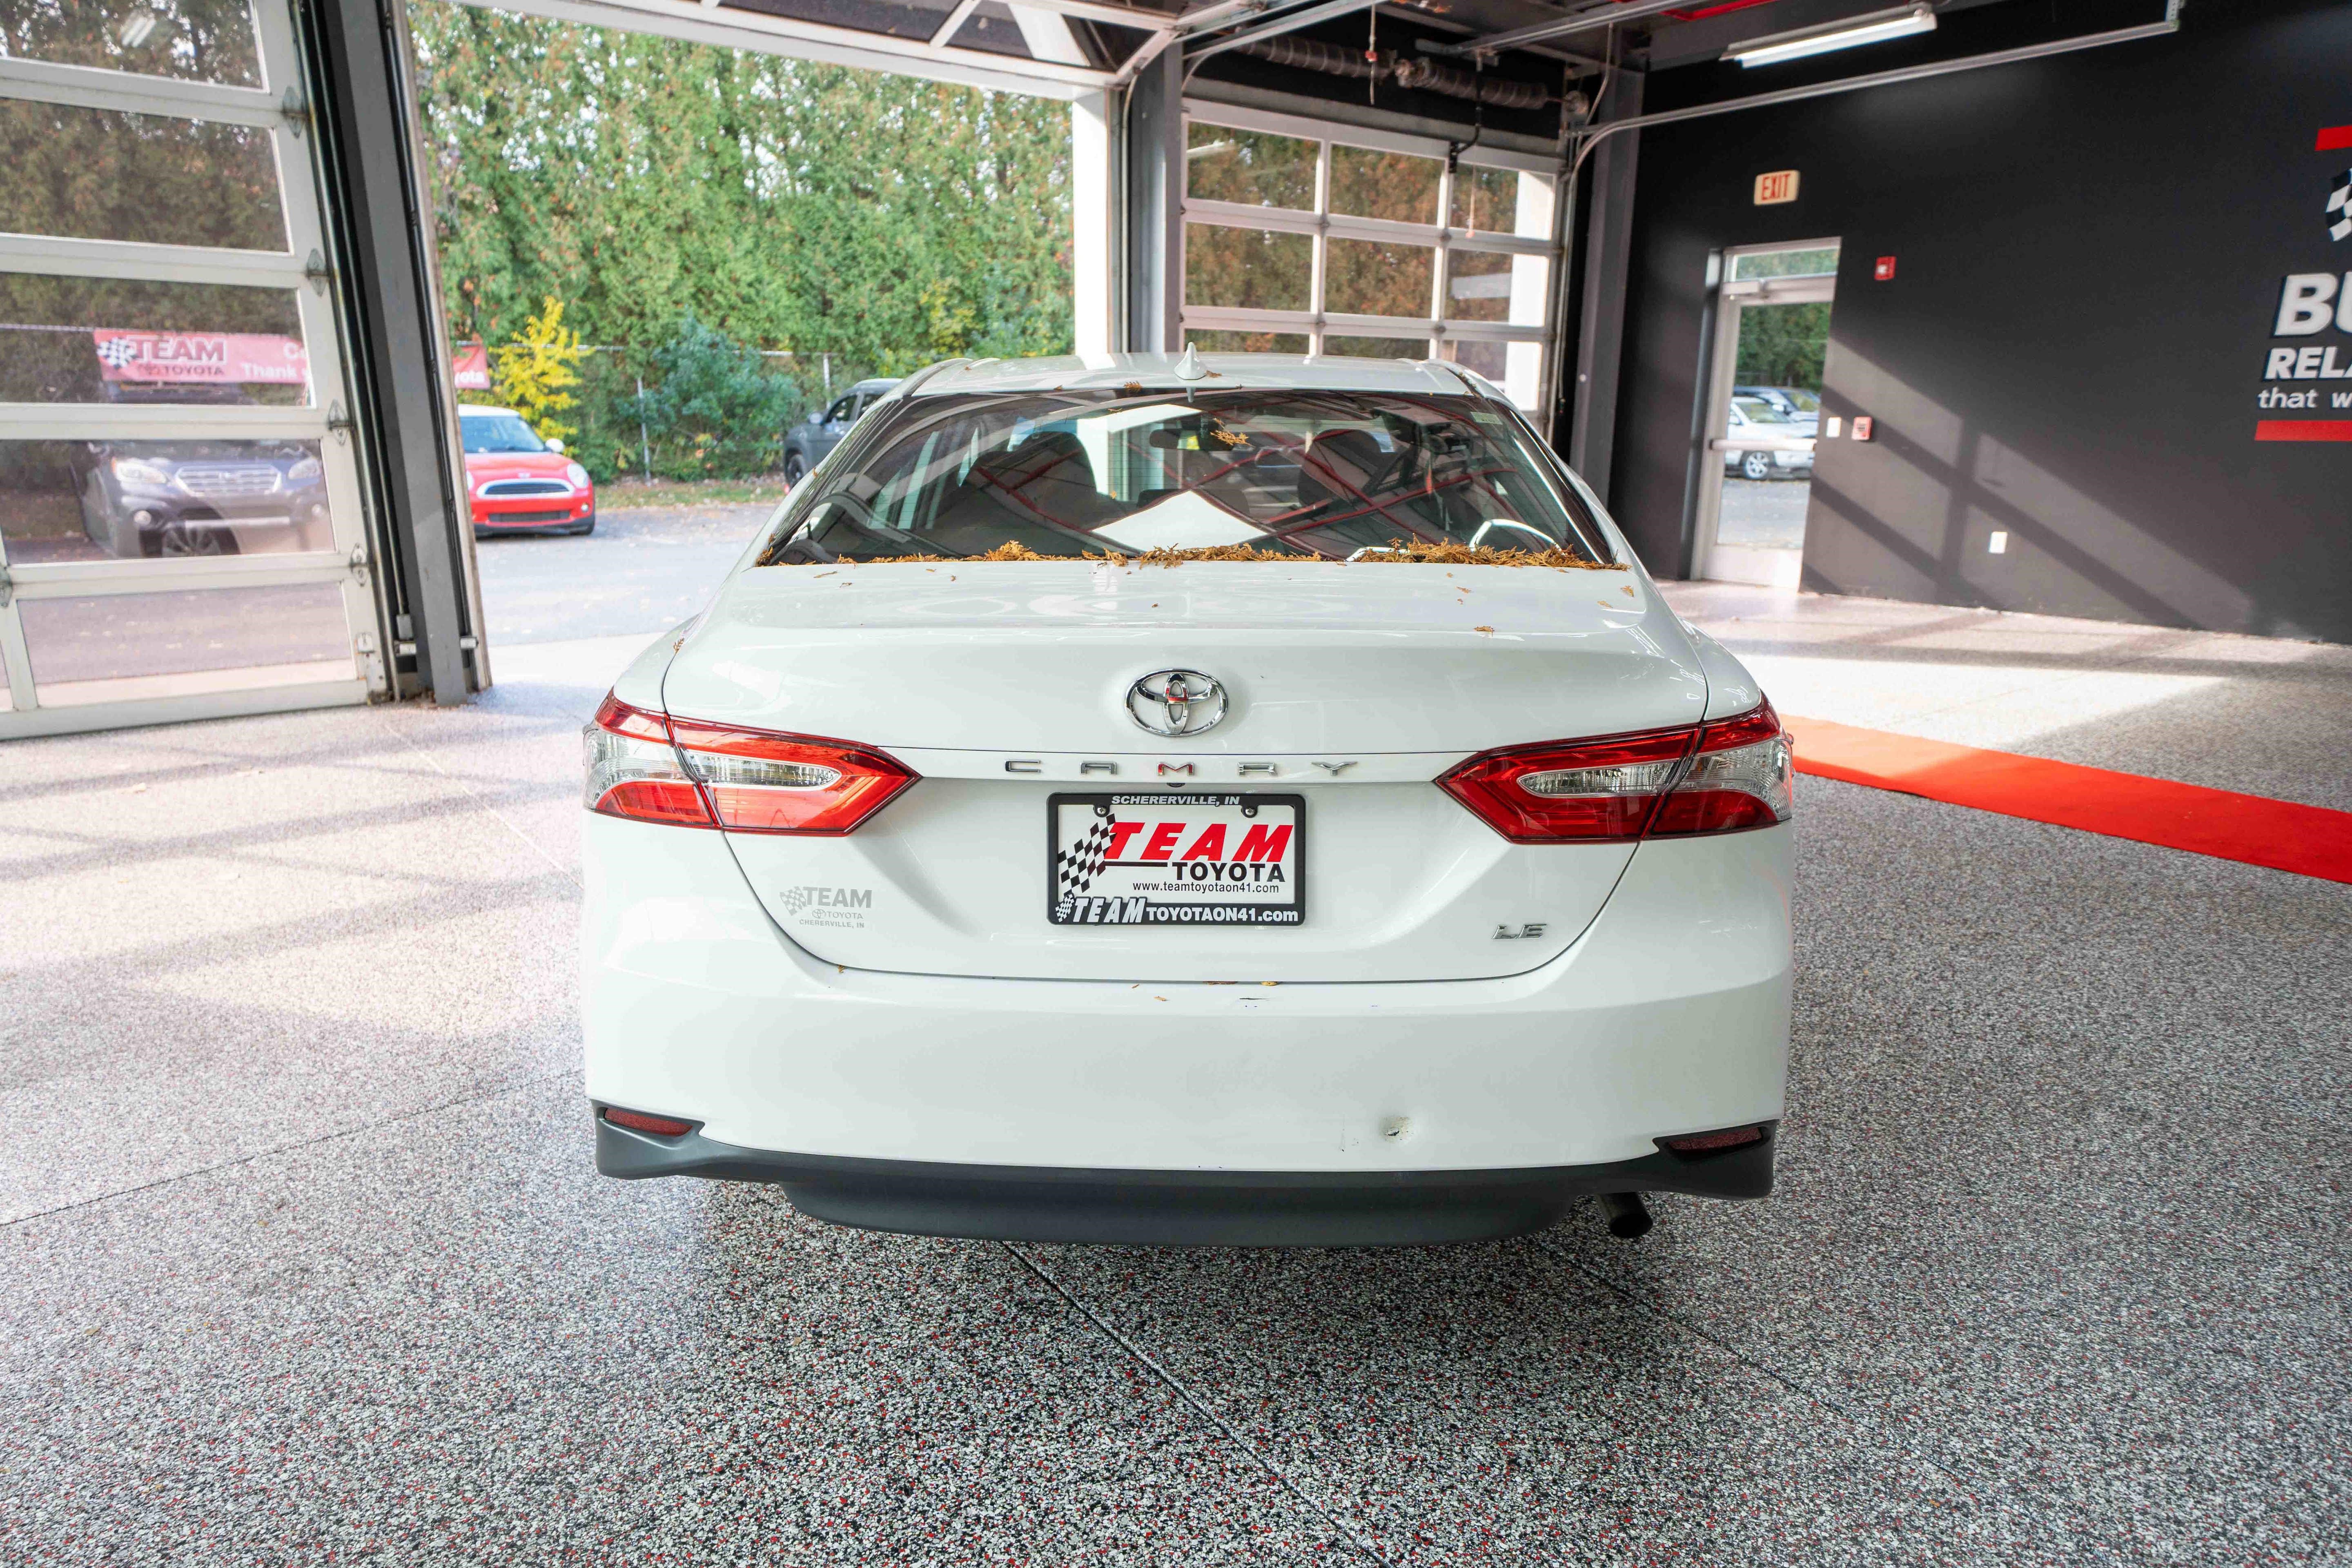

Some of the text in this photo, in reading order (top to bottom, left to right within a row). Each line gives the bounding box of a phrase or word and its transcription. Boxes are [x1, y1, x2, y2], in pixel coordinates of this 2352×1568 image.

[1761, 173, 1791, 200] EXIT
[127, 335, 227, 364] TEAM
[165, 366, 224, 376] TOYOTA
[241, 363, 297, 379] Thank
[2258, 387, 2319, 408] that
[1005, 758, 1359, 777] CAMRY
[1111, 795, 1240, 806] SCHERERVILLE, IN
[1104, 822, 1293, 862] TEAM
[1172, 862, 1285, 882] TOYOTA
[803, 886, 872, 908] TEAM
[1133, 881, 1279, 894] www.teamtoyotaon41.com
[827, 911, 863, 919] TOYOTA
[1073, 898, 1298, 923] TEAM TOYOTAON41.com
[1492, 924, 1547, 940] LE
